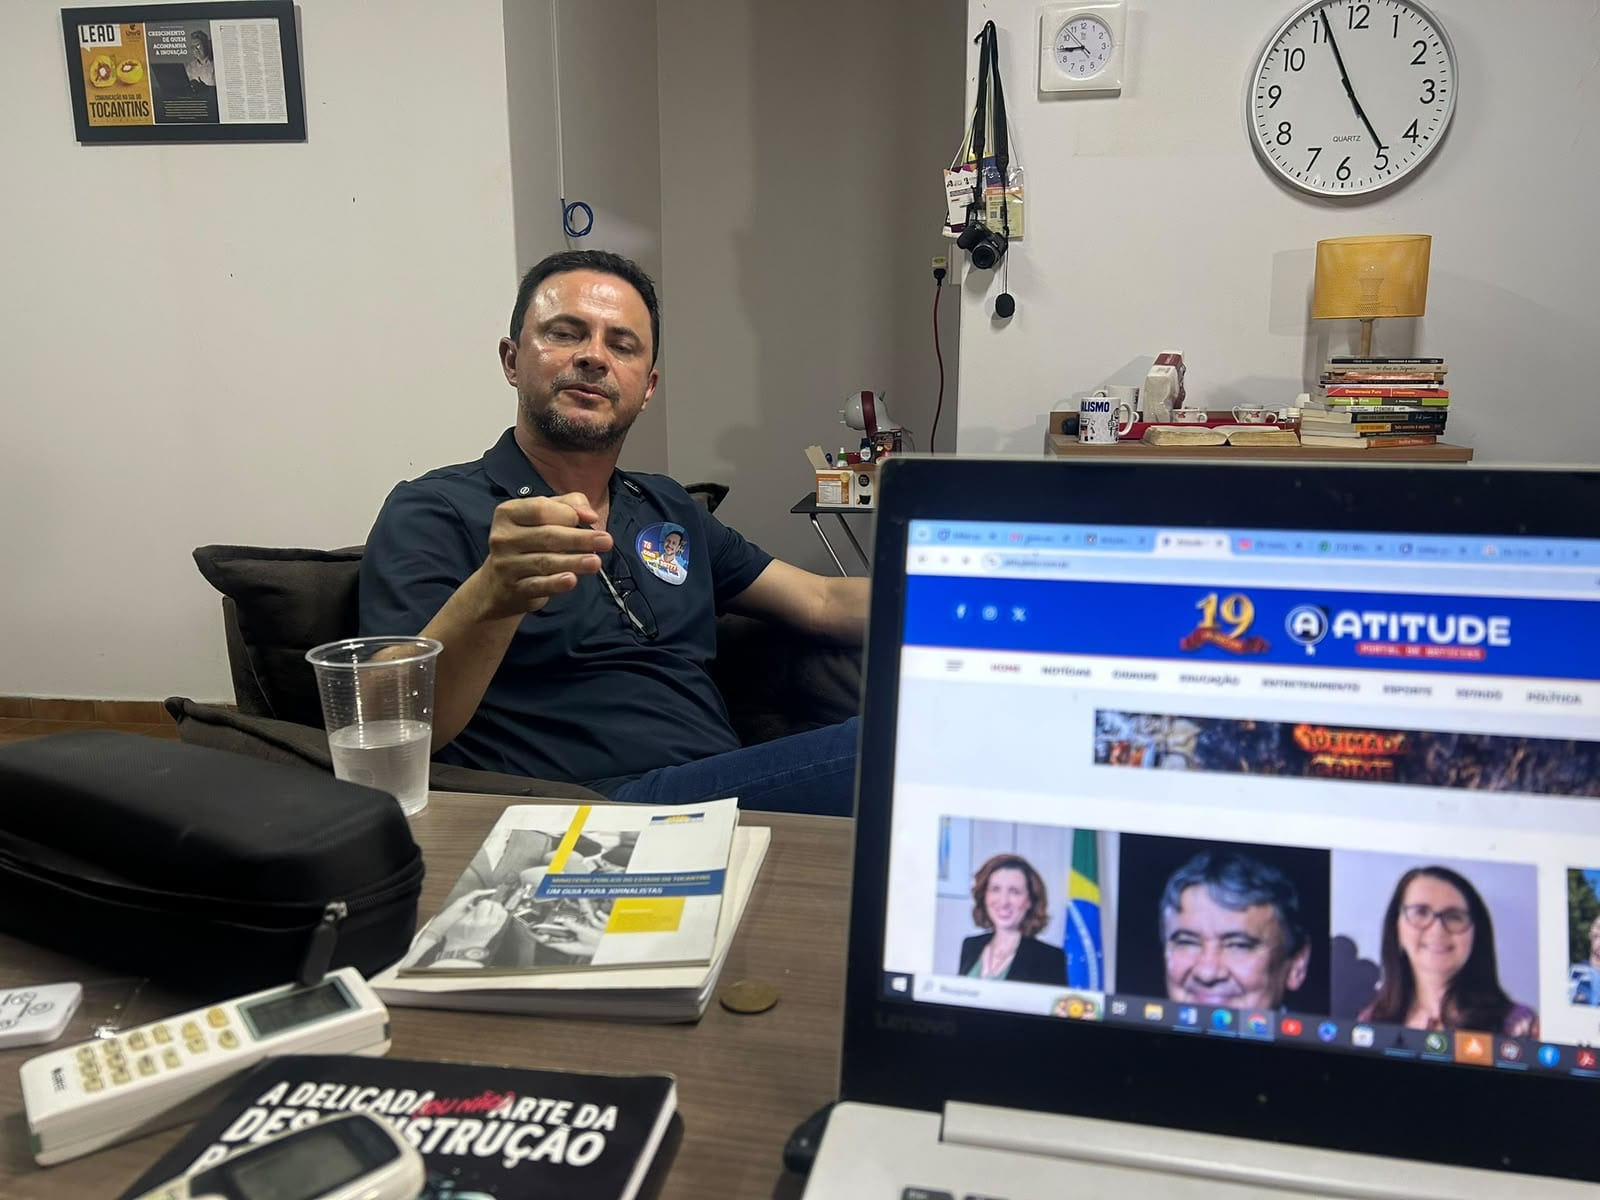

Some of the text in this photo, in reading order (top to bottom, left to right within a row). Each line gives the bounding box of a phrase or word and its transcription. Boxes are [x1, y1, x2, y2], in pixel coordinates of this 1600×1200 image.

[1348, 4, 1370, 30] 12
[1391, 14, 1400, 39] 1
[80, 25, 115, 42] LEAD
[1312, 19, 1330, 44] 11
[1283, 48, 1306, 72] 10
[1410, 40, 1428, 66] 2
[1268, 85, 1282, 109] 9
[1419, 79, 1436, 104] 3
[89, 101, 149, 118] TOCANTINS
[1276, 121, 1292, 146] 8
[1402, 118, 1420, 144] 4
[1306, 147, 1322, 172] 7
[1336, 156, 1351, 181] 6
[1373, 145, 1390, 171] 5
[1195, 592, 1256, 638] 19
[1332, 609, 1511, 647] ATITUDE
[1359, 643, 1400, 655] PORTAL
[1404, 646, 1419, 656] DE
[990, 663, 1021, 673] HOME
[608, 887, 663, 895] JORNALISTAS
[256, 1081, 290, 1106] A
[285, 1081, 435, 1115] DELICADA
[486, 1095, 574, 1127] ARTE
[571, 1103, 619, 1132] DA
